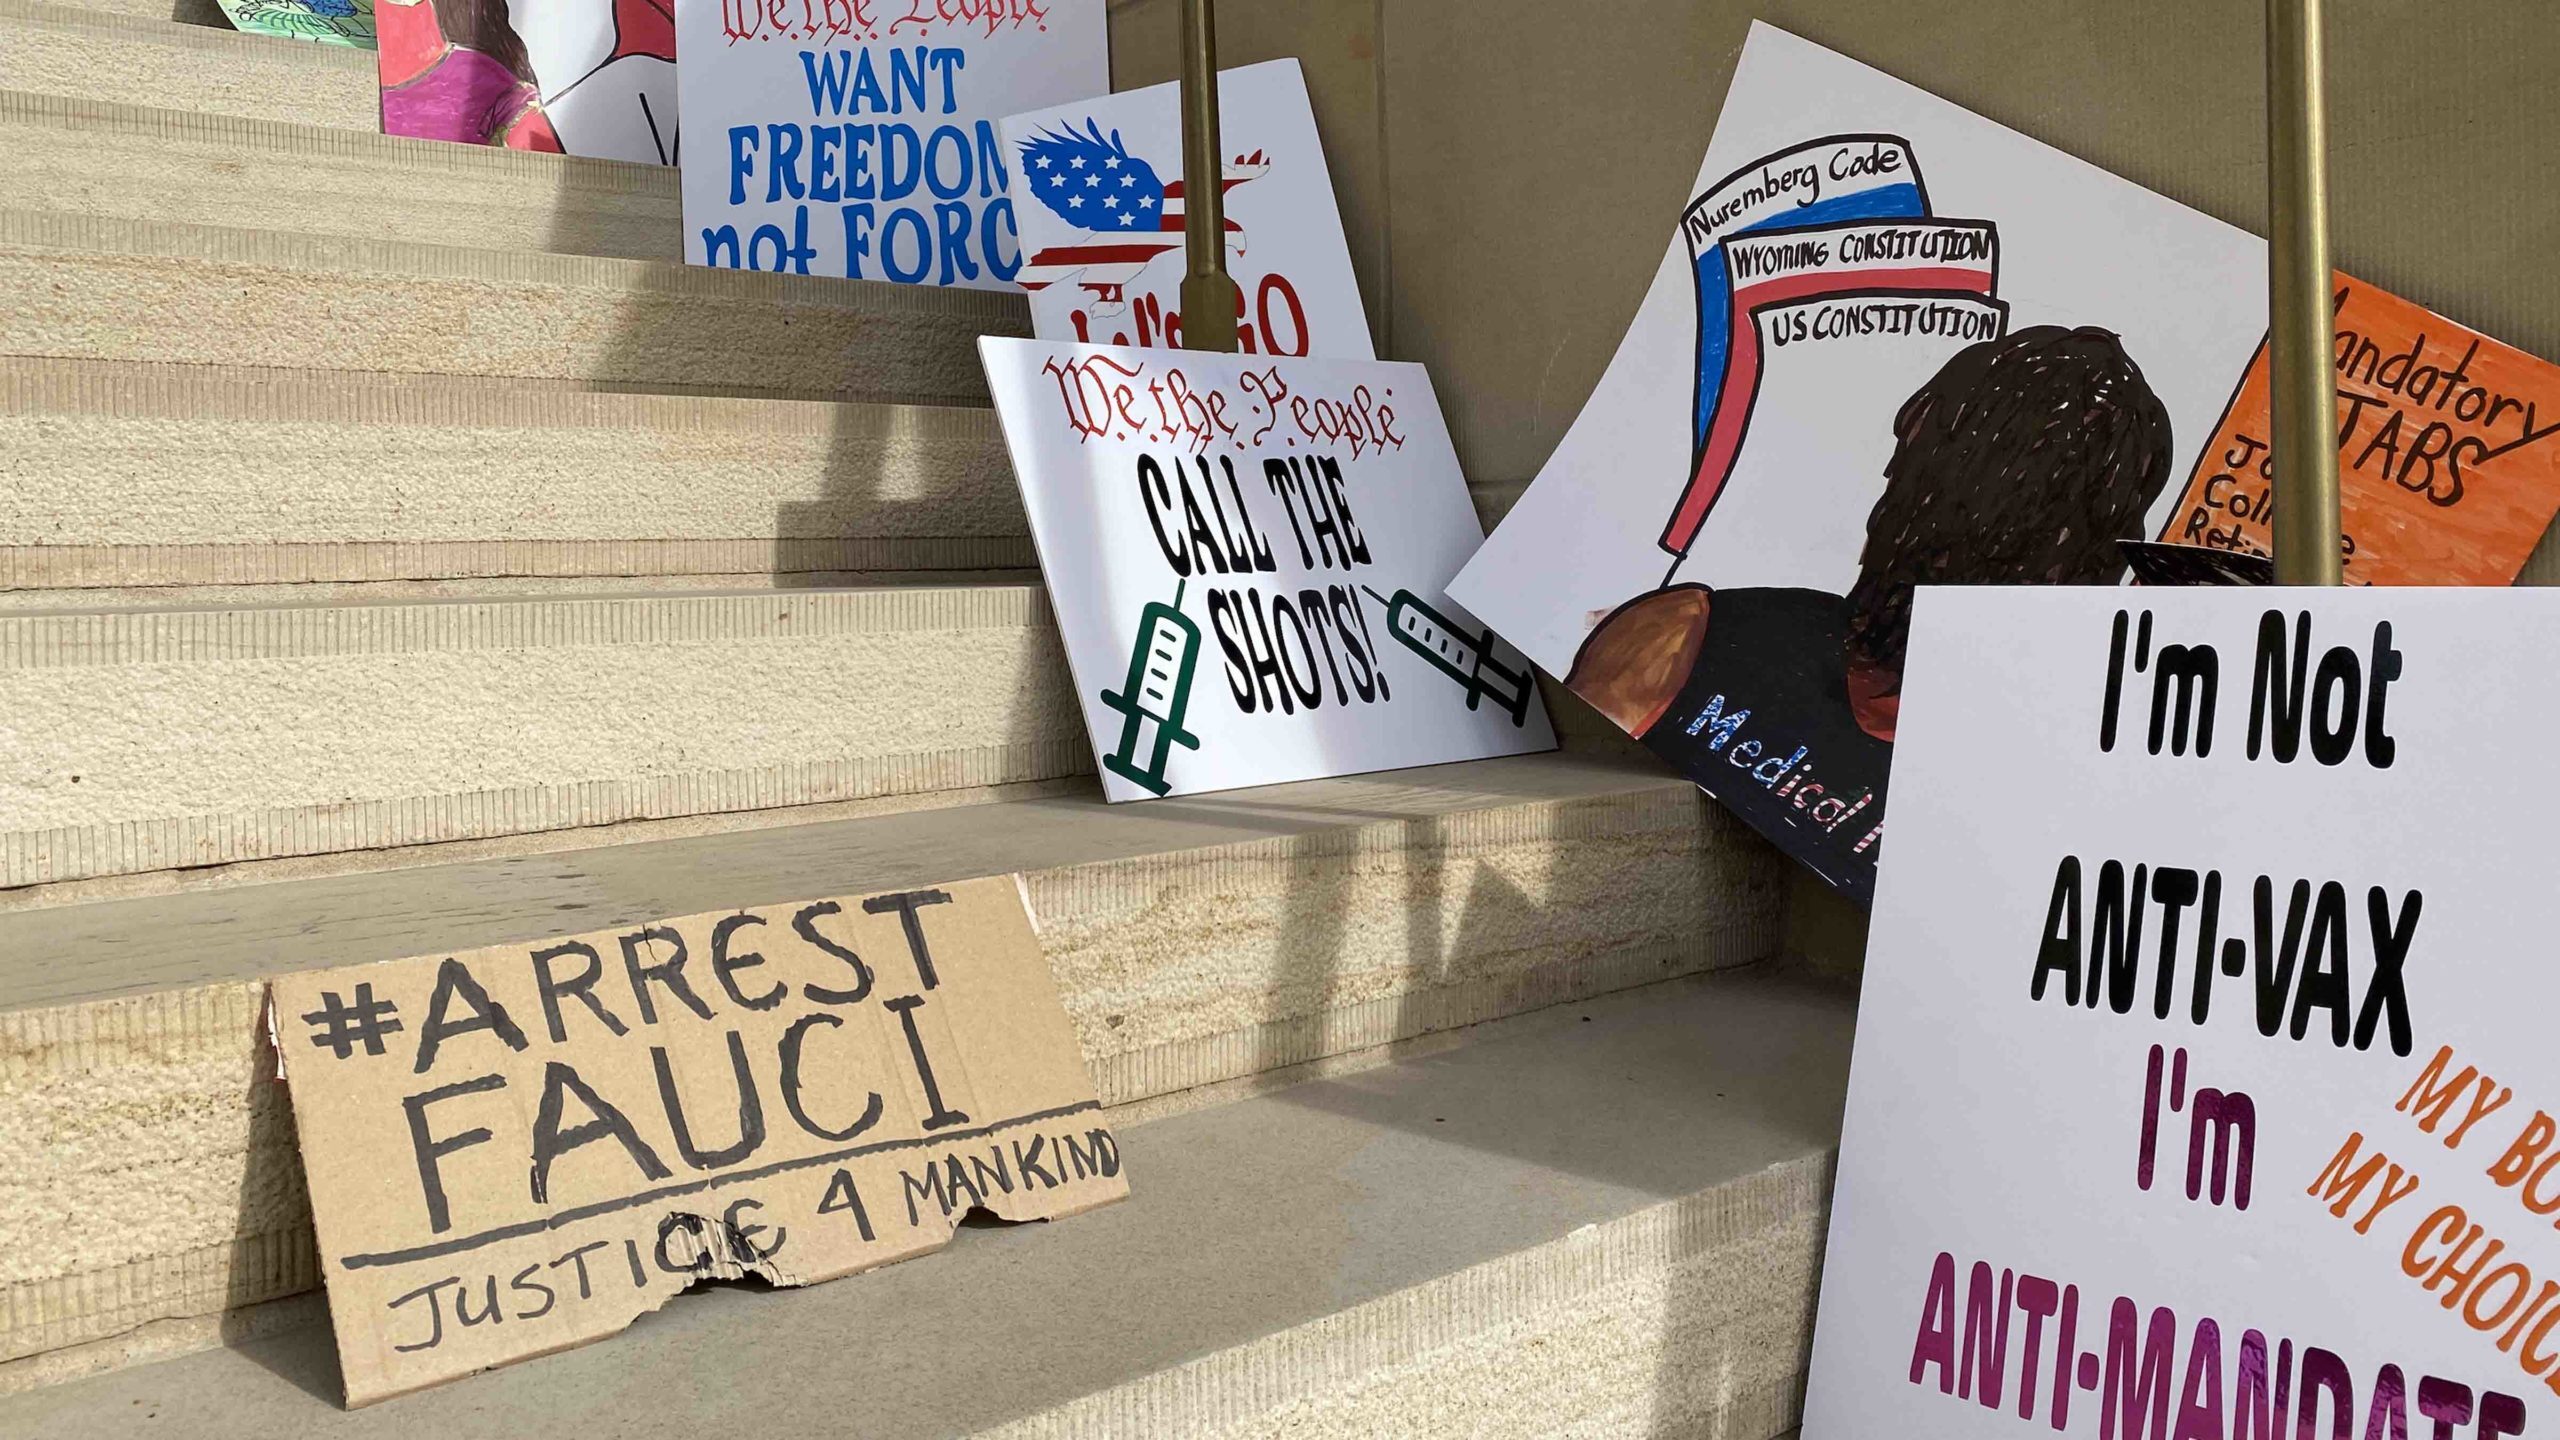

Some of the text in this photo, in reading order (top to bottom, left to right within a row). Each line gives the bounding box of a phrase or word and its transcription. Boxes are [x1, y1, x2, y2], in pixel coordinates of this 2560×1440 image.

[799, 46, 965, 116] WANT
[702, 197, 1024, 287] not FORC
[1688, 142, 1901, 245] Nuremberg Code
[1733, 228, 1990, 279] WYOMING CONSTITUTION
[1772, 303, 1997, 346] US CONSTITUTION
[2334, 287, 2560, 466] andatory
[1042, 354, 1406, 461] We the People
[1137, 453, 1372, 578] CALL THE
[1207, 583, 1391, 715] SHOTS!
[2100, 609, 2402, 769] I'm Not
[1685, 693, 1873, 833] Medical
[300, 888, 953, 1074] #ARREST
[2030, 855, 2423, 1057] ANTI-VAX
[403, 995, 970, 1234] FAUCI
[2137, 1043, 2257, 1211] I'm
[2395, 1045, 2560, 1230] MY BO
[388, 1128, 1122, 1353] JUSTICE 4 MANKIND
[2306, 1131, 2560, 1396] MY CHOIC
